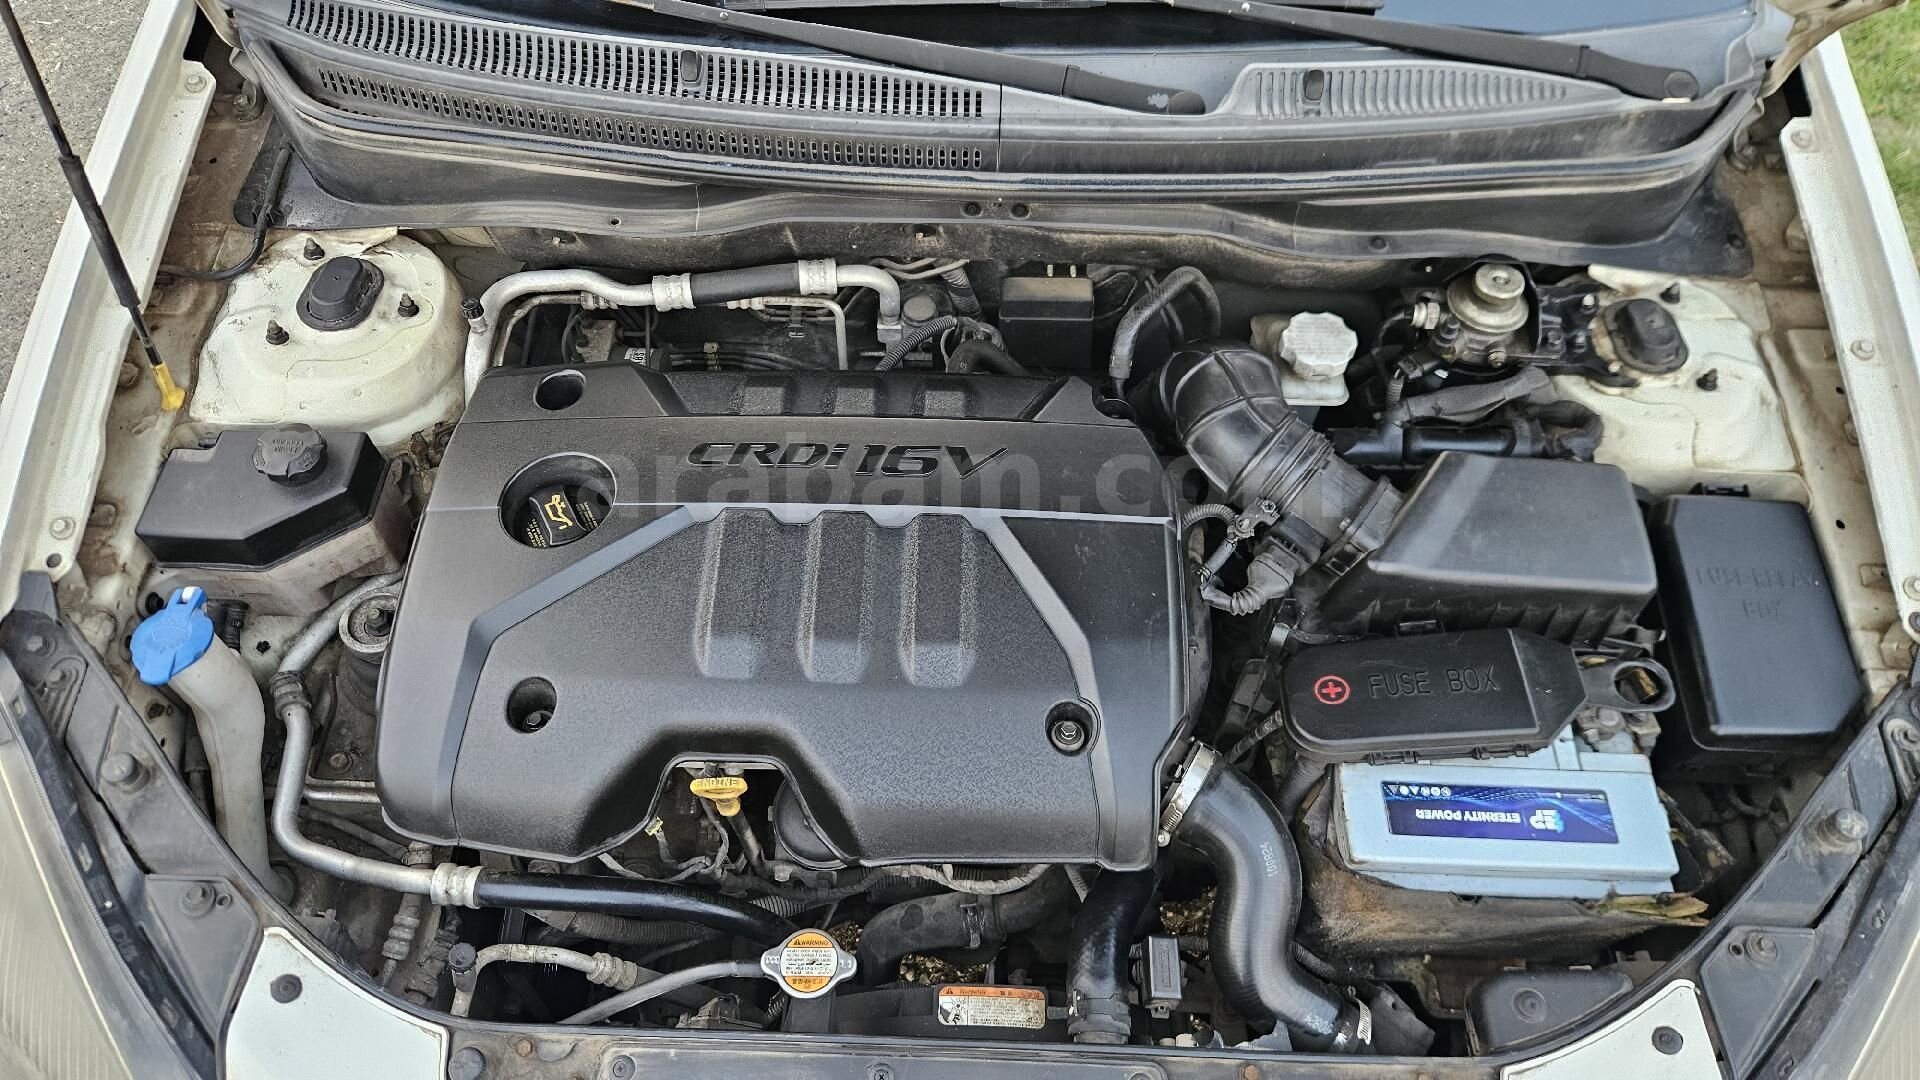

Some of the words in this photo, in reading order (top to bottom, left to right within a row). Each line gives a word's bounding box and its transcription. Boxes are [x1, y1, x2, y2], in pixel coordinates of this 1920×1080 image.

[687, 441, 849, 469] CRDi
[855, 444, 1008, 480] 16V
[1368, 670, 1432, 698] FUSE
[1447, 665, 1498, 692] BOX
[695, 778, 738, 788] ENGINE
[1415, 808, 1462, 821] POWER
[1464, 810, 1521, 824] ETERNITY
[1260, 841, 1278, 877] 100824
